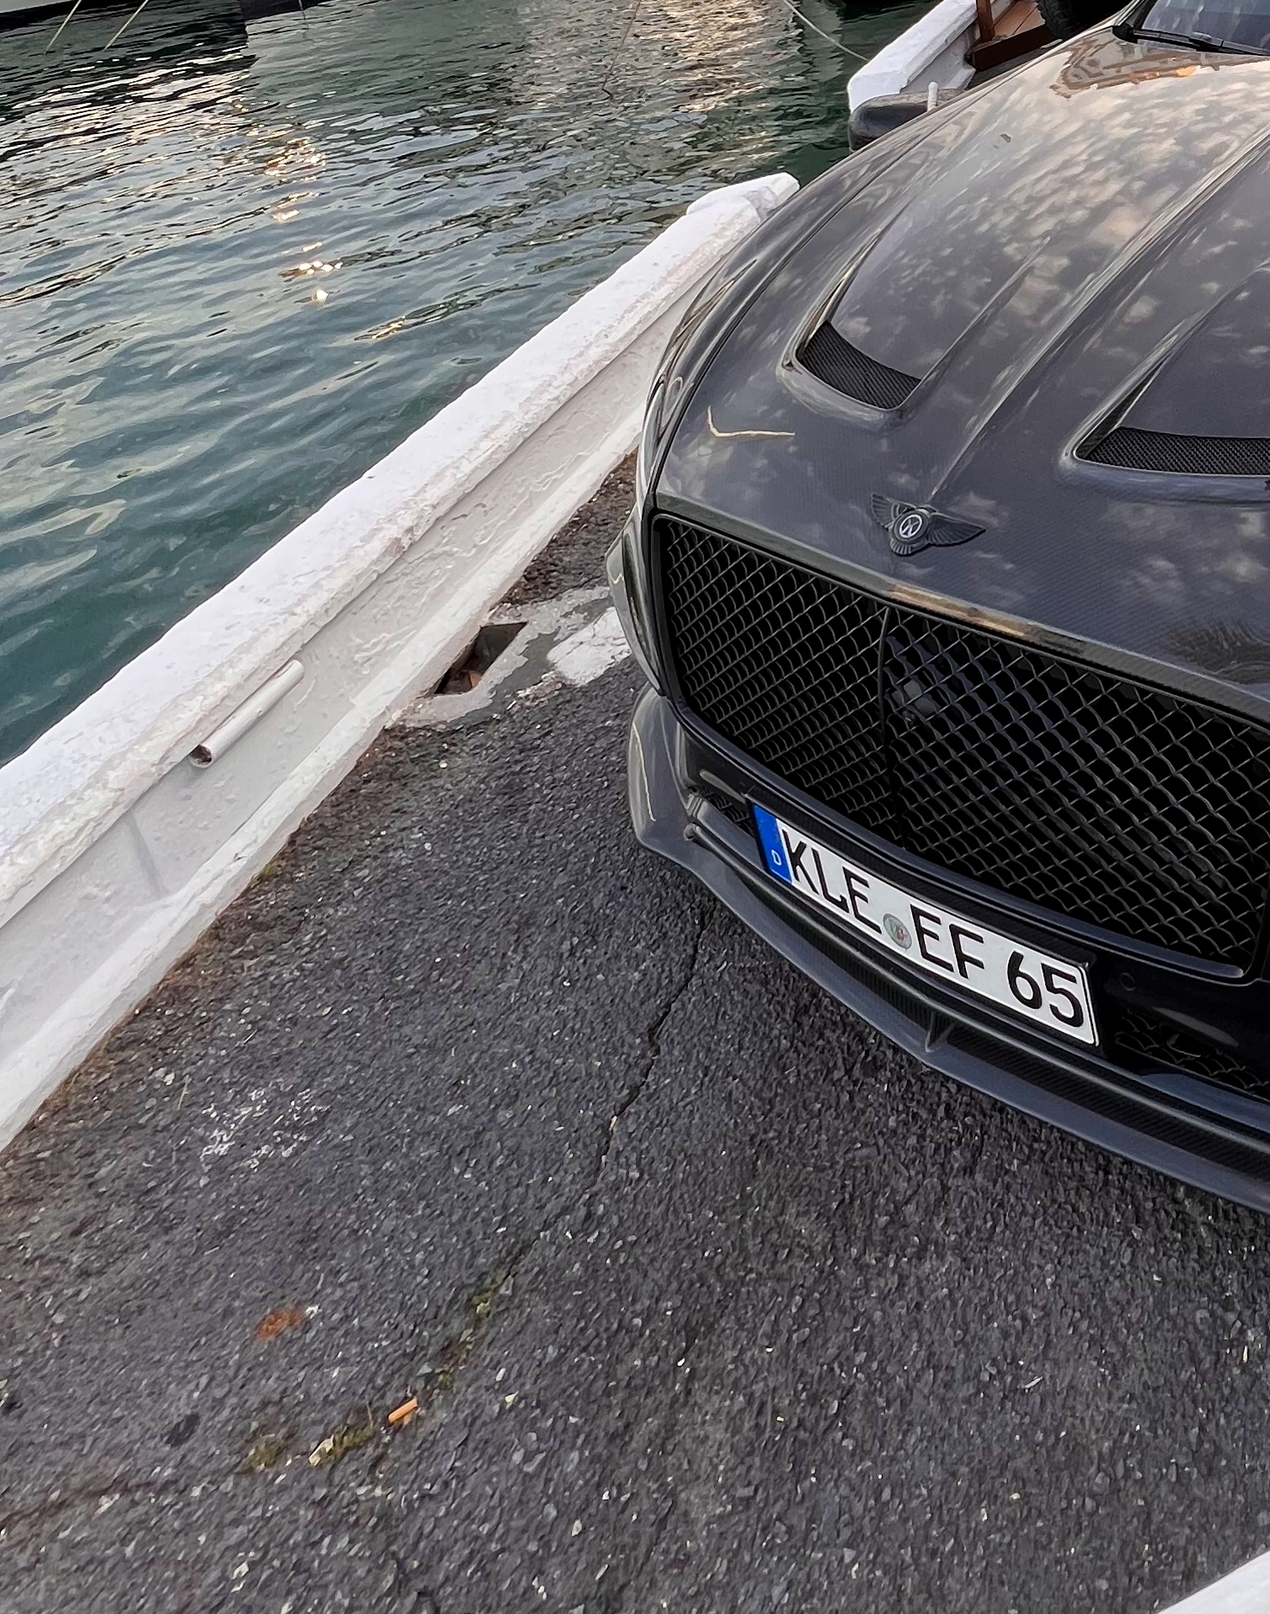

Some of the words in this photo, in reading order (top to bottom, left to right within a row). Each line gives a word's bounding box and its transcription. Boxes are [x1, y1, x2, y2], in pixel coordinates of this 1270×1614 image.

[771, 849, 782, 866] D
[782, 828, 882, 935] KLE
[910, 904, 986, 980] EF
[1007, 951, 1085, 1028] 65
